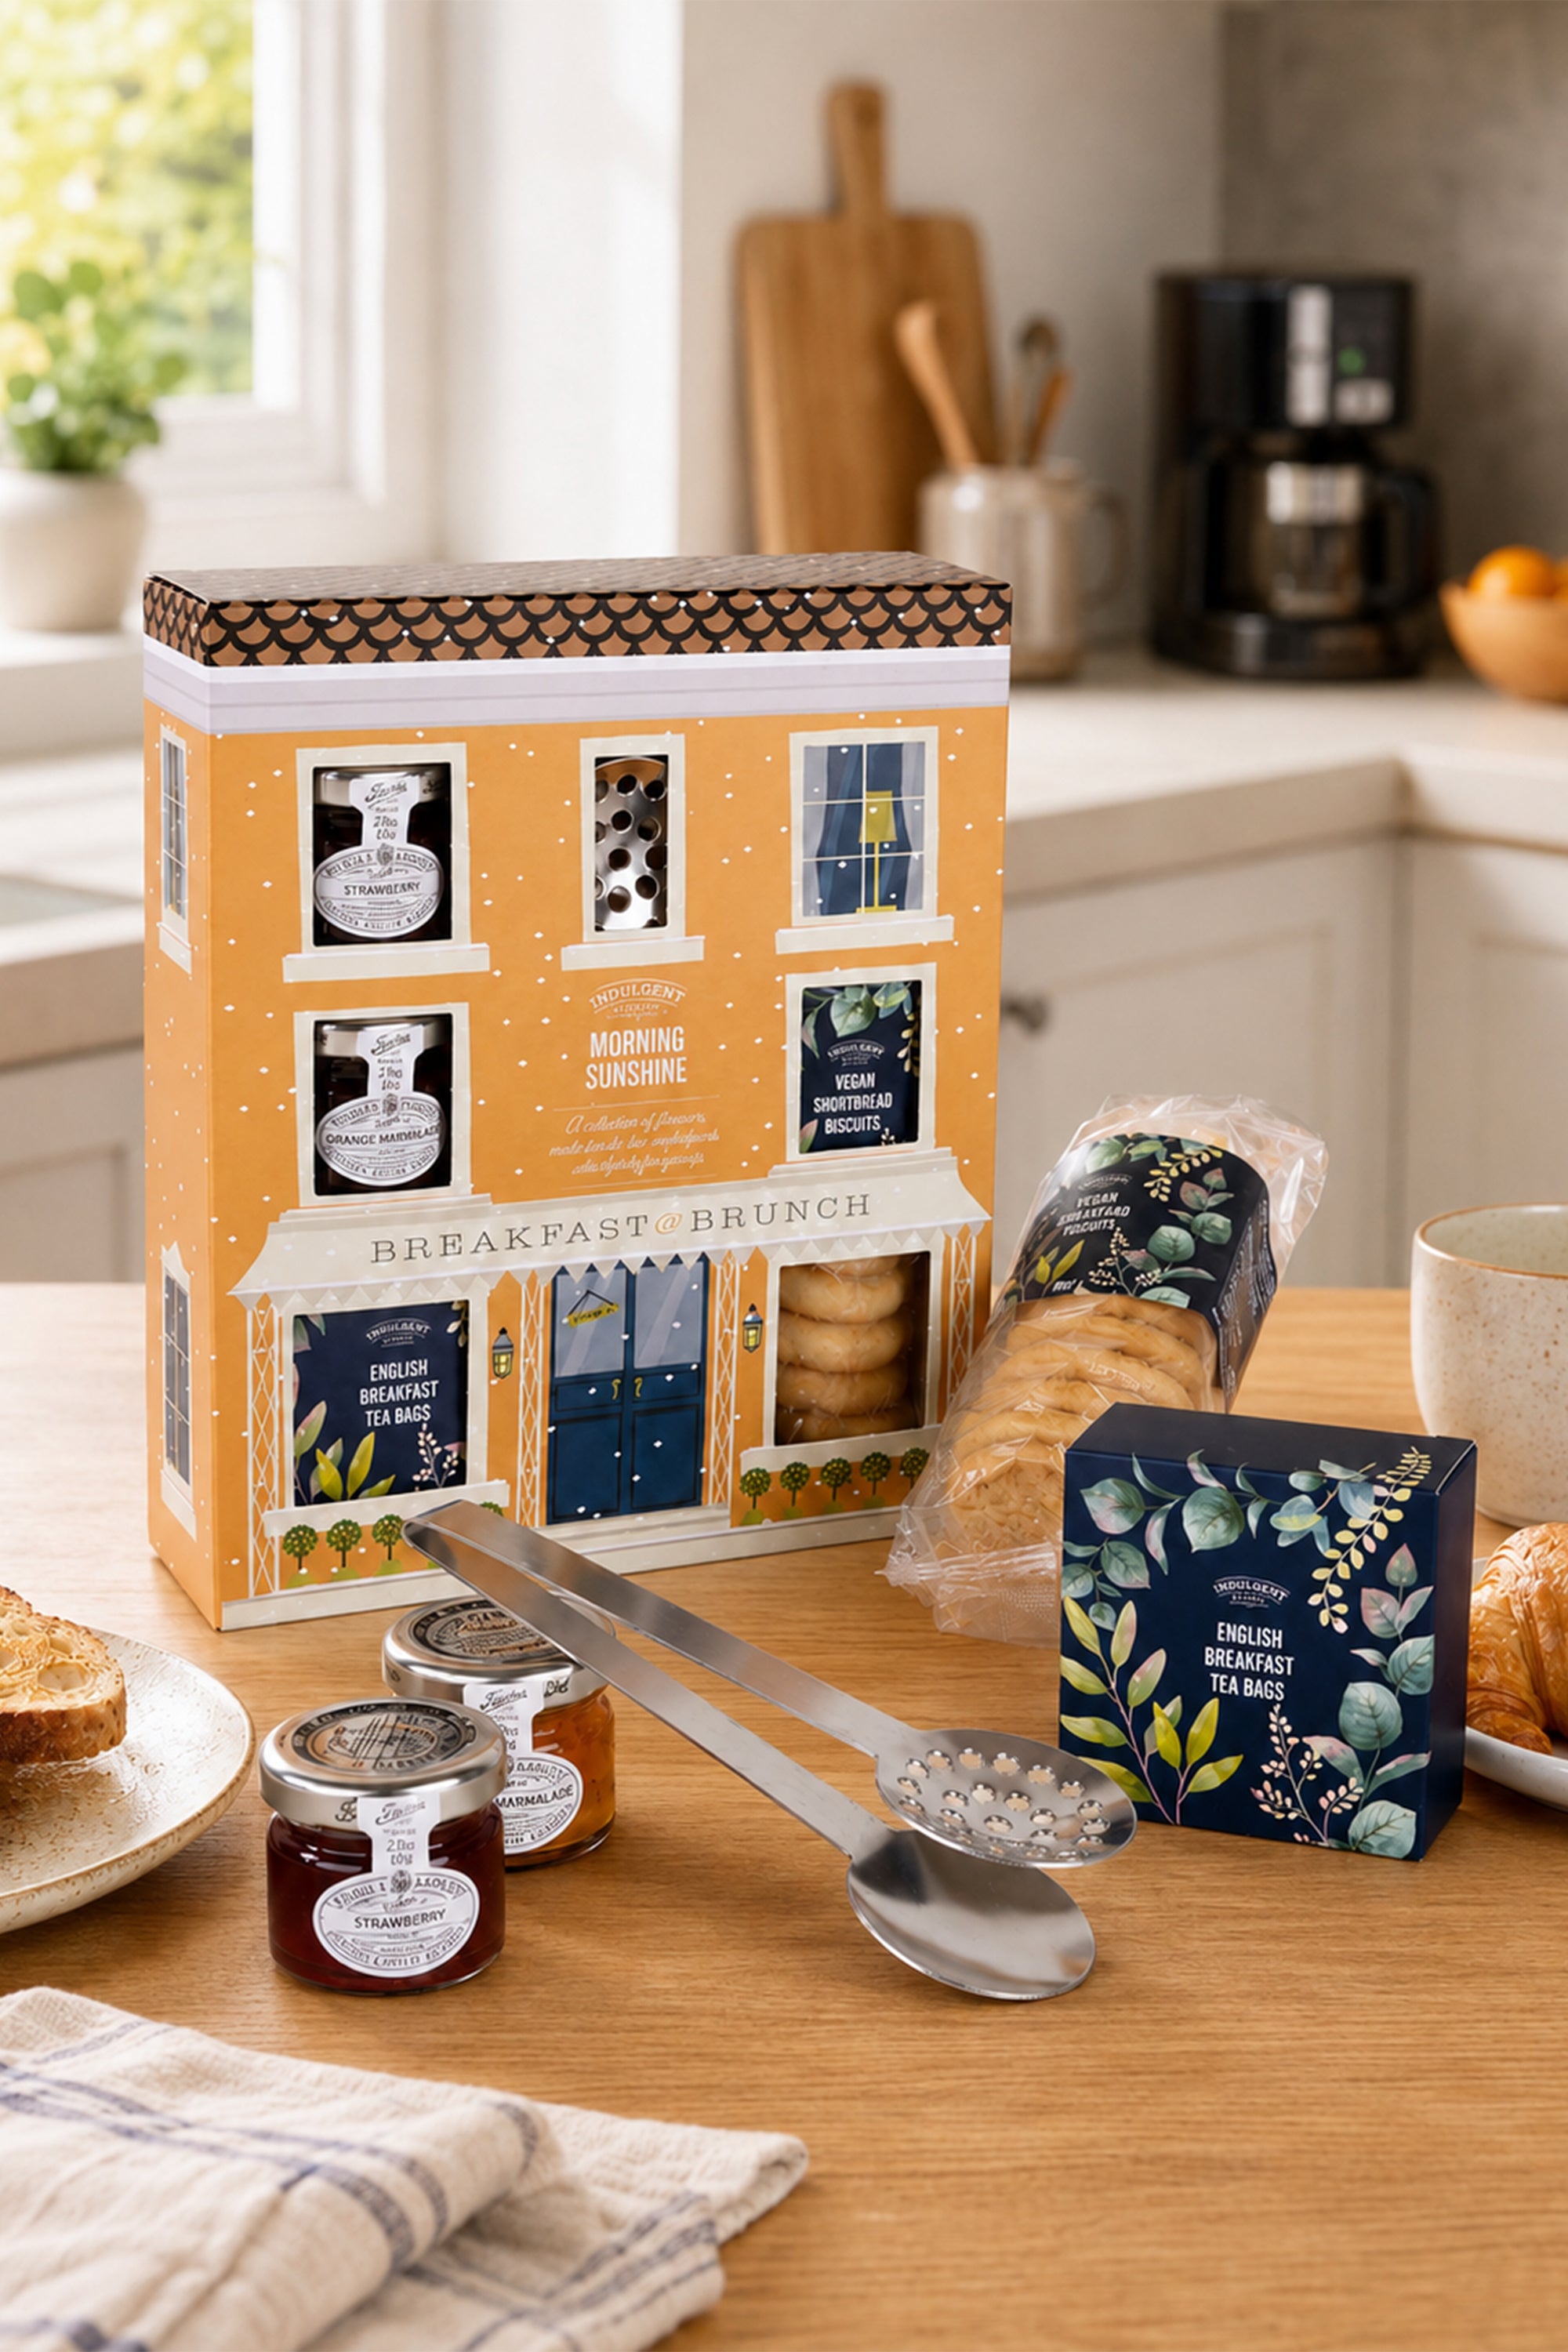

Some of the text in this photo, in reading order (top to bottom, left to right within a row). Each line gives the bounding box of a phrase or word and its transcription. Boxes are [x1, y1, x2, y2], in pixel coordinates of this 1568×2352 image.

[589, 983, 686, 1009] INDULGENT
[590, 1025, 684, 1058] MORNING
[586, 1057, 687, 1090] SUNSHINE
[835, 1073, 875, 1090] VEGAN
[813, 1092, 892, 1113] SHORTBREAD
[565, 1115, 584, 1134] A
[825, 1115, 880, 1134] BISCUITS
[370, 1359, 428, 1382] ENGLISH
[359, 1380, 439, 1406] BREAKFAST
[365, 1403, 431, 1428] TEA BAGS
[1217, 1621, 1283, 1649] ENGLISH
[1205, 1646, 1294, 1675] BREAKFAST
[1210, 1672, 1284, 1701] TEA BAGS
[354, 1908, 446, 1929] STRAWBERRY
